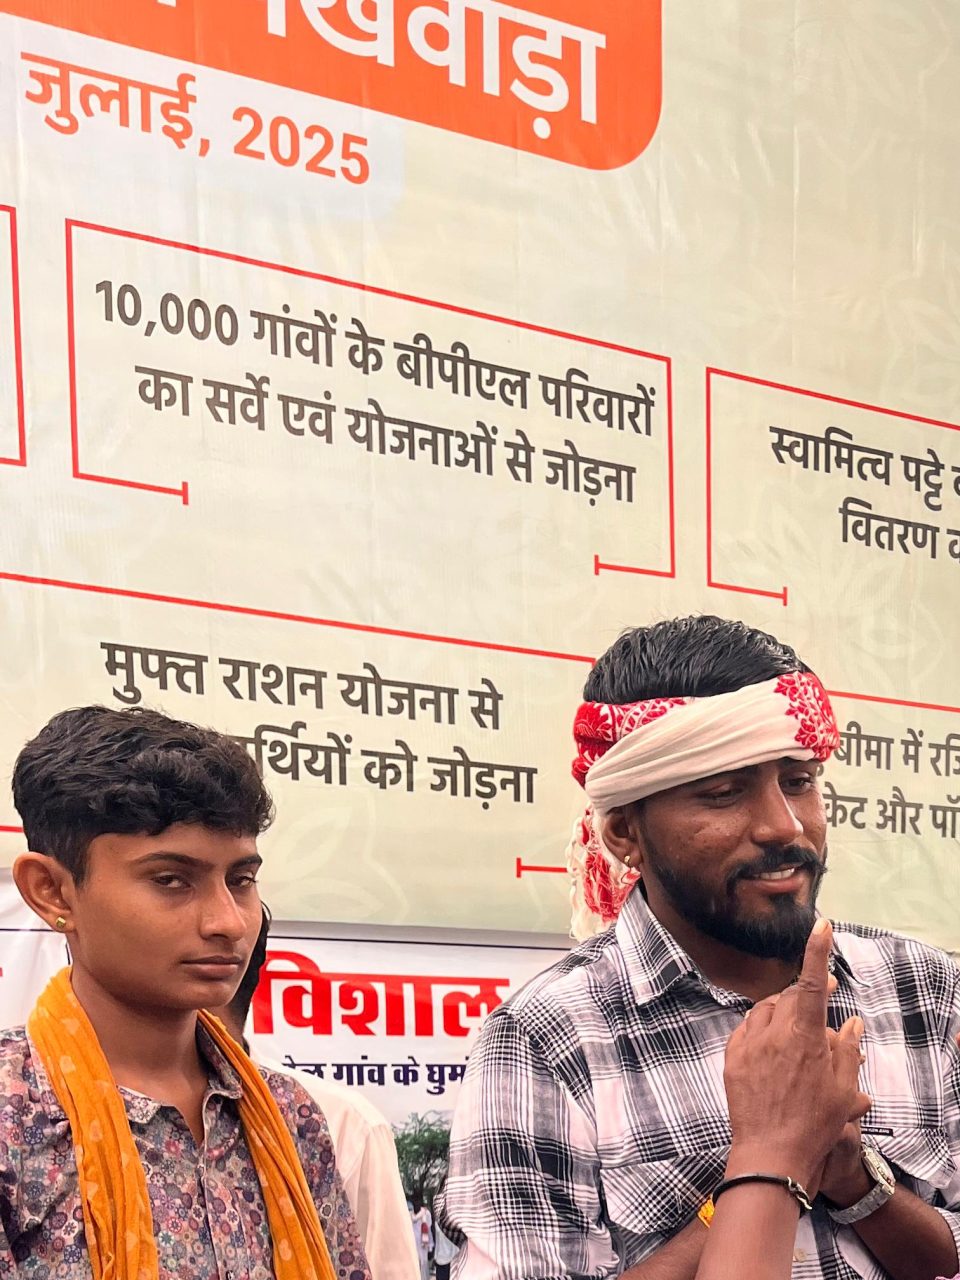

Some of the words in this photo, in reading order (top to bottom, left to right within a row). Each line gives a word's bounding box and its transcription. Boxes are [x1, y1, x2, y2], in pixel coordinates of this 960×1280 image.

[267, 0, 606, 139] खवाड़ा
[20, 51, 210, 157] जुलाई,
[232, 106, 371, 184] 2025
[95, 280, 239, 346] 10,000
[250, 304, 338, 367] गांवों
[345, 317, 384, 375] के
[394, 333, 530, 409] बीपीएल
[538, 369, 655, 436] परिवारों
[135, 366, 193, 416] का
[203, 372, 270, 430] सर्वे
[278, 391, 336, 443] एवं
[345, 398, 498, 476] योजनाओं
[503, 430, 536, 483] से
[543, 439, 636, 506] जोड़ना
[769, 426, 893, 485] स्वामित्व
[901, 448, 944, 511] पट्टे
[838, 496, 940, 559] वितरण
[100, 642, 208, 704] मुफ्त
[219, 658, 327, 709] राशन
[337, 663, 459, 725] योजना
[468, 678, 504, 730] से
[361, 740, 418, 792] को
[428, 746, 538, 810] जोड़ना
[834, 721, 894, 770] बीमा
[901, 728, 925, 773] में
[876, 786, 923, 835] और
[254, 951, 510, 1036] विशाल
[332, 1055, 387, 1086] गांव
[392, 1056, 420, 1086] के
